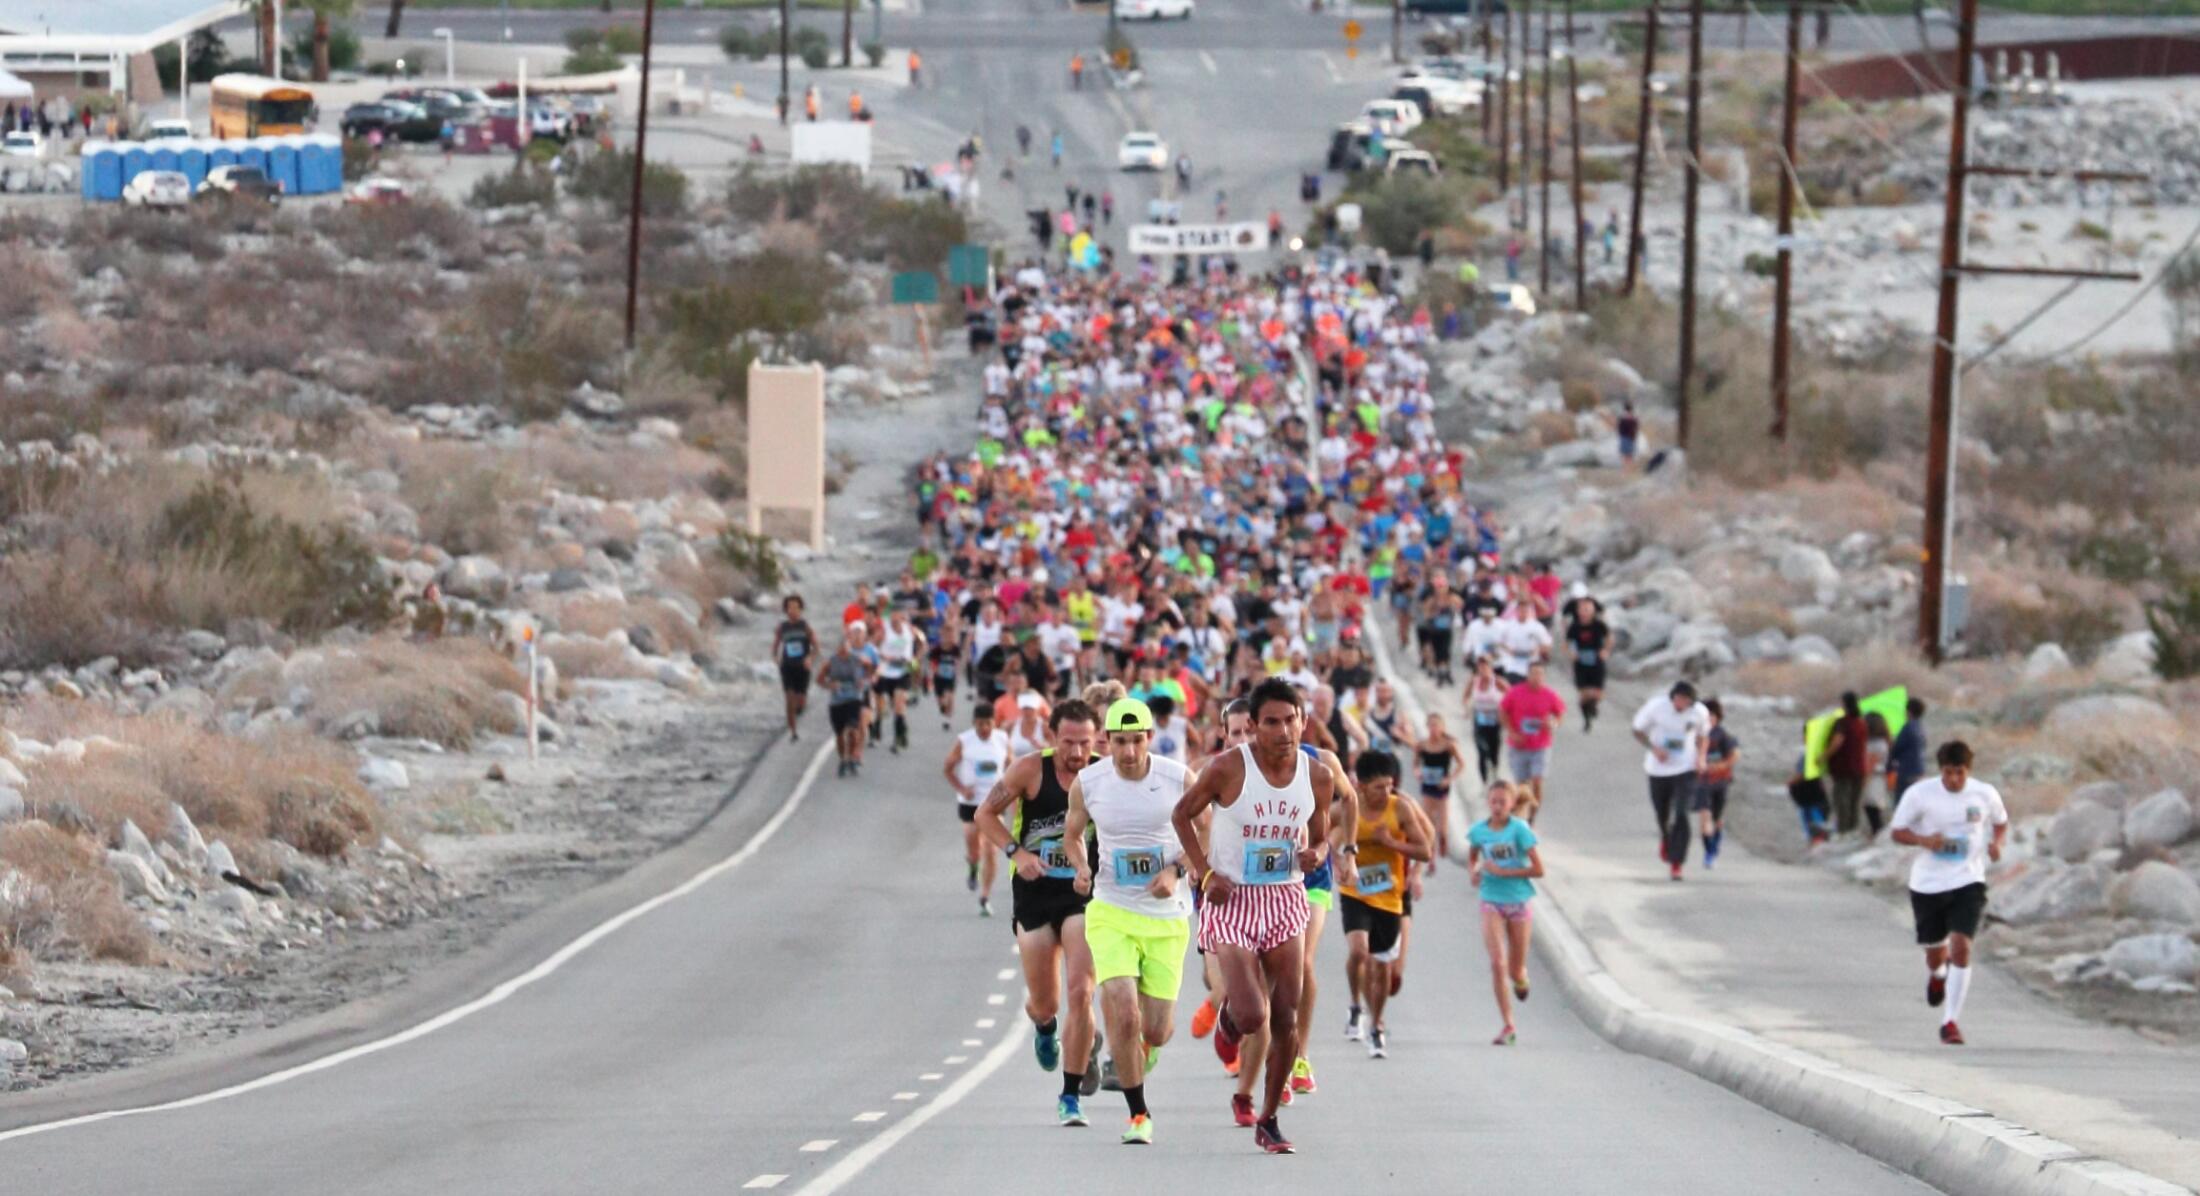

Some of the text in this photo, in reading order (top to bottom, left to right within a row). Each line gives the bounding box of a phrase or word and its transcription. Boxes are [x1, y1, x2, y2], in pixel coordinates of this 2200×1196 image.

[1253, 799, 1300, 821] HIGH
[1242, 824, 1300, 840] SIERRA
[1131, 859, 1150, 875] 10
[1265, 855, 1275, 872] 8
